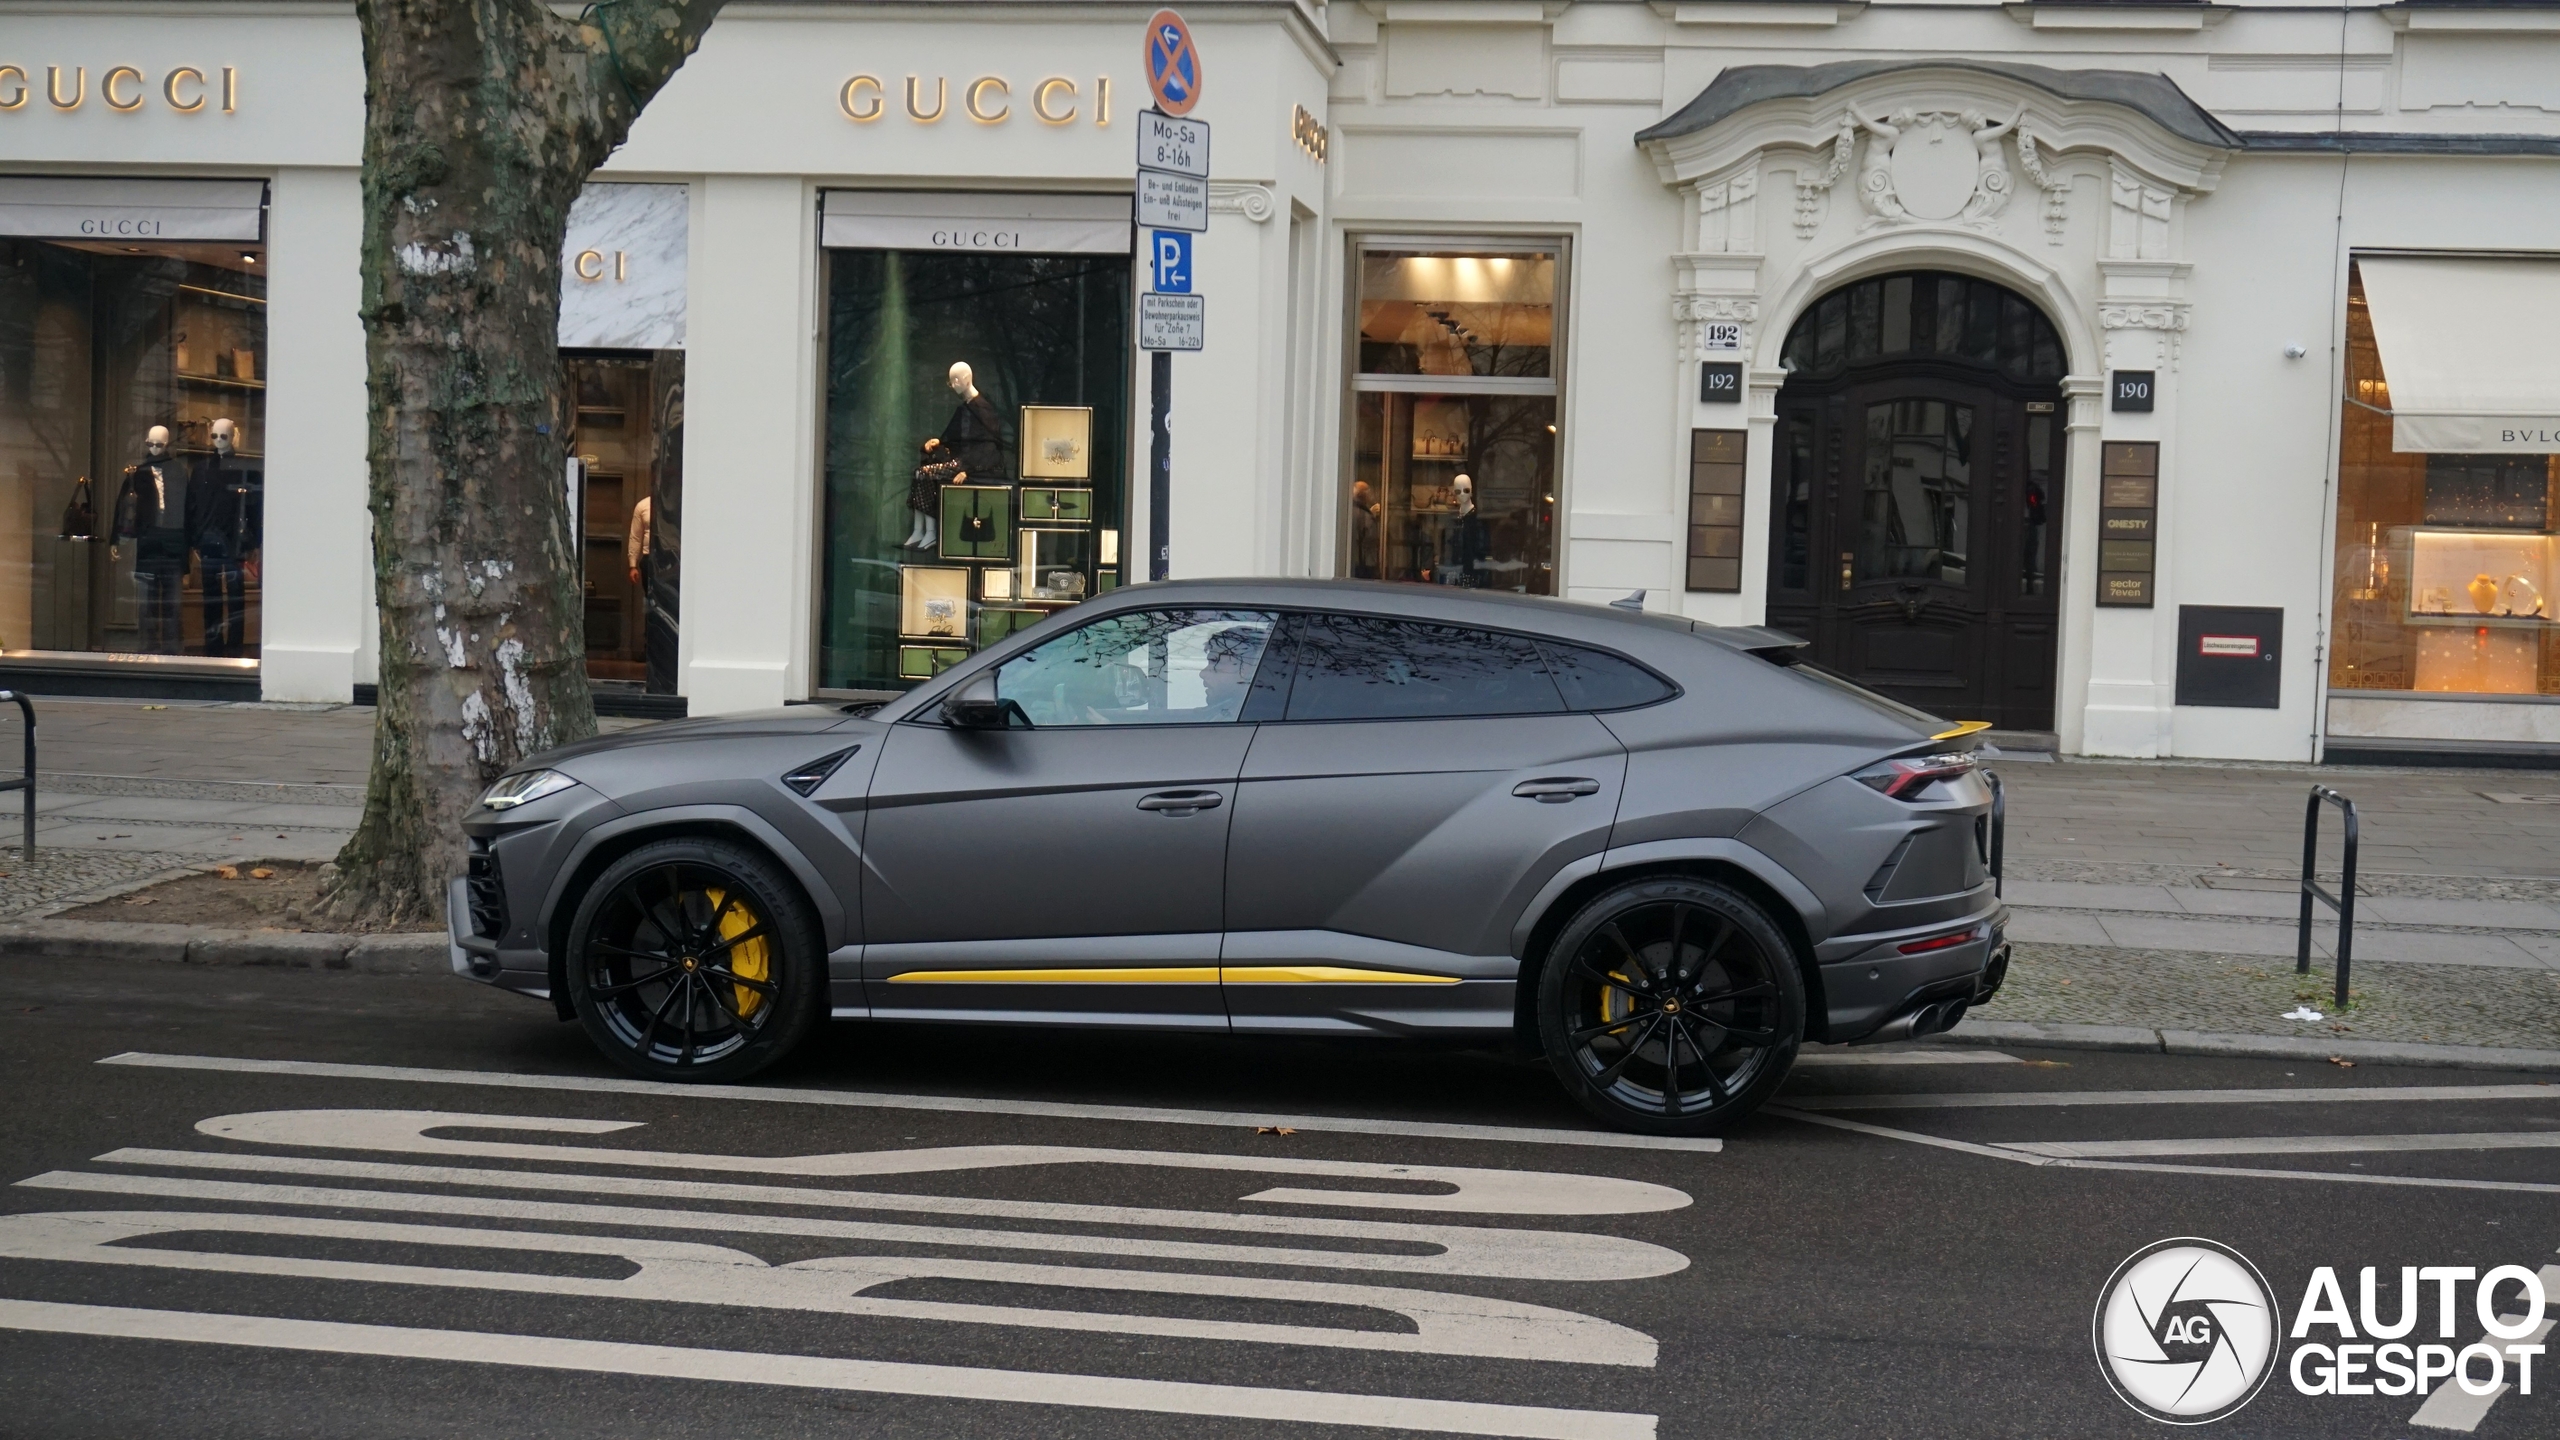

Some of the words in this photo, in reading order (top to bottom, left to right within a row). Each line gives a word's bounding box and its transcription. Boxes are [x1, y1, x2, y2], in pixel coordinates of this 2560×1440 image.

[0, 64, 236, 112] GUCCI
[839, 74, 1108, 124] GUCCI
[1153, 120, 1195, 144] Mo-Sa
[1157, 145, 1191, 168] 8-16h
[1148, 178, 1160, 190] Be-
[1161, 181, 1173, 191] und
[1174, 181, 1199, 194] Entladen
[1143, 192, 1157, 204] Ein-
[1159, 195, 1171, 206] und
[1172, 196, 1203, 211] Aussteigen
[1167, 209, 1181, 221] frei
[81, 219, 160, 235] GUCCI
[931, 230, 1019, 248] GUCCI
[1159, 237, 1181, 286] P
[1146, 298, 1156, 308] mit
[1157, 297, 1186, 308] Parkschein
[1186, 299, 1198, 309] oder
[1144, 309, 1201, 322] Bewohnerparkausweis
[1154, 322, 1164, 333] für
[1167, 323, 1184, 334] Zone
[1186, 324, 1191, 333] 7
[1708, 324, 1738, 341] 192
[1144, 335, 1166, 346] Mo-Sa
[1178, 336, 1200, 347] 16-22h
[1708, 373, 1735, 389] 192
[2119, 382, 2148, 399] 190
[2107, 518, 2149, 529] ONESTY
[2110, 579, 2142, 588] sector
[2109, 588, 2141, 597] 7even
